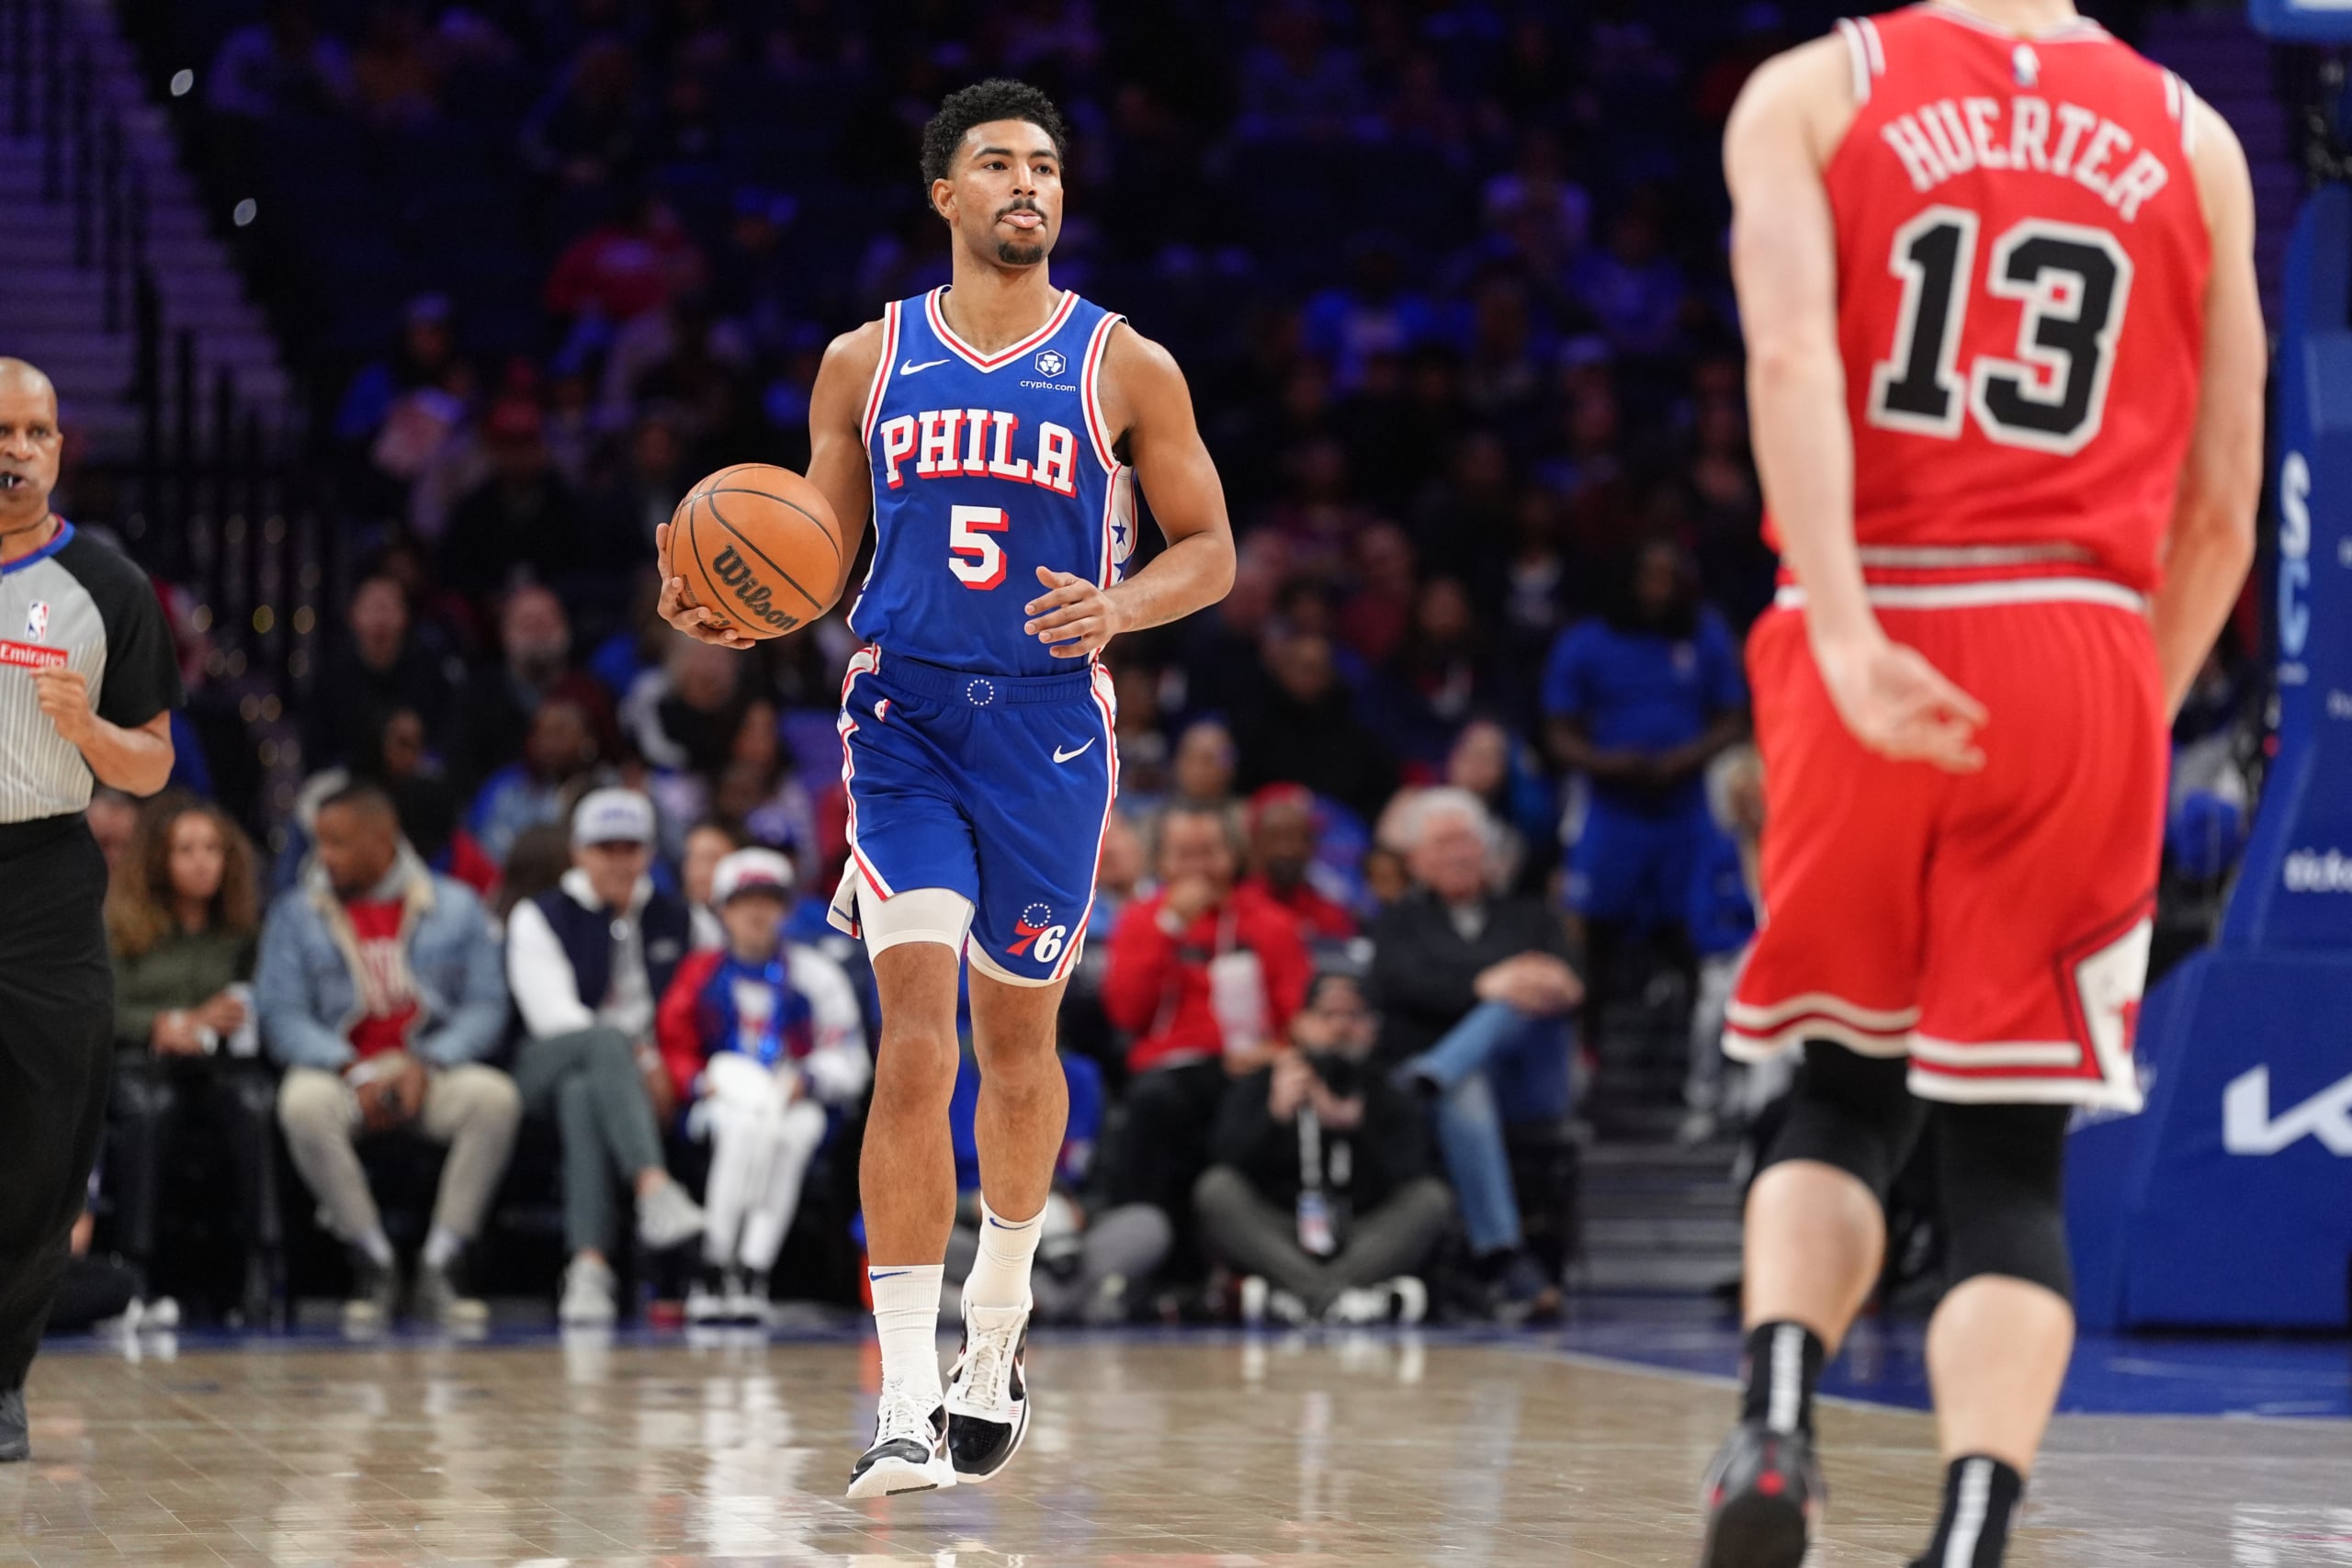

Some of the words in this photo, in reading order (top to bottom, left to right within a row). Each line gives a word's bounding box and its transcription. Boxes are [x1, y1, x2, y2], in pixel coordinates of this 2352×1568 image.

[1881, 96, 2169, 223] HUERTER
[1866, 203, 2134, 457] 13
[1020, 378, 1076, 392] crypto.com
[880, 408, 1079, 499] PHILA
[713, 544, 799, 630] Wilson
[948, 504, 1010, 591] 5
[0, 643, 67, 668] Emirates
[1005, 919, 1067, 963] 76
